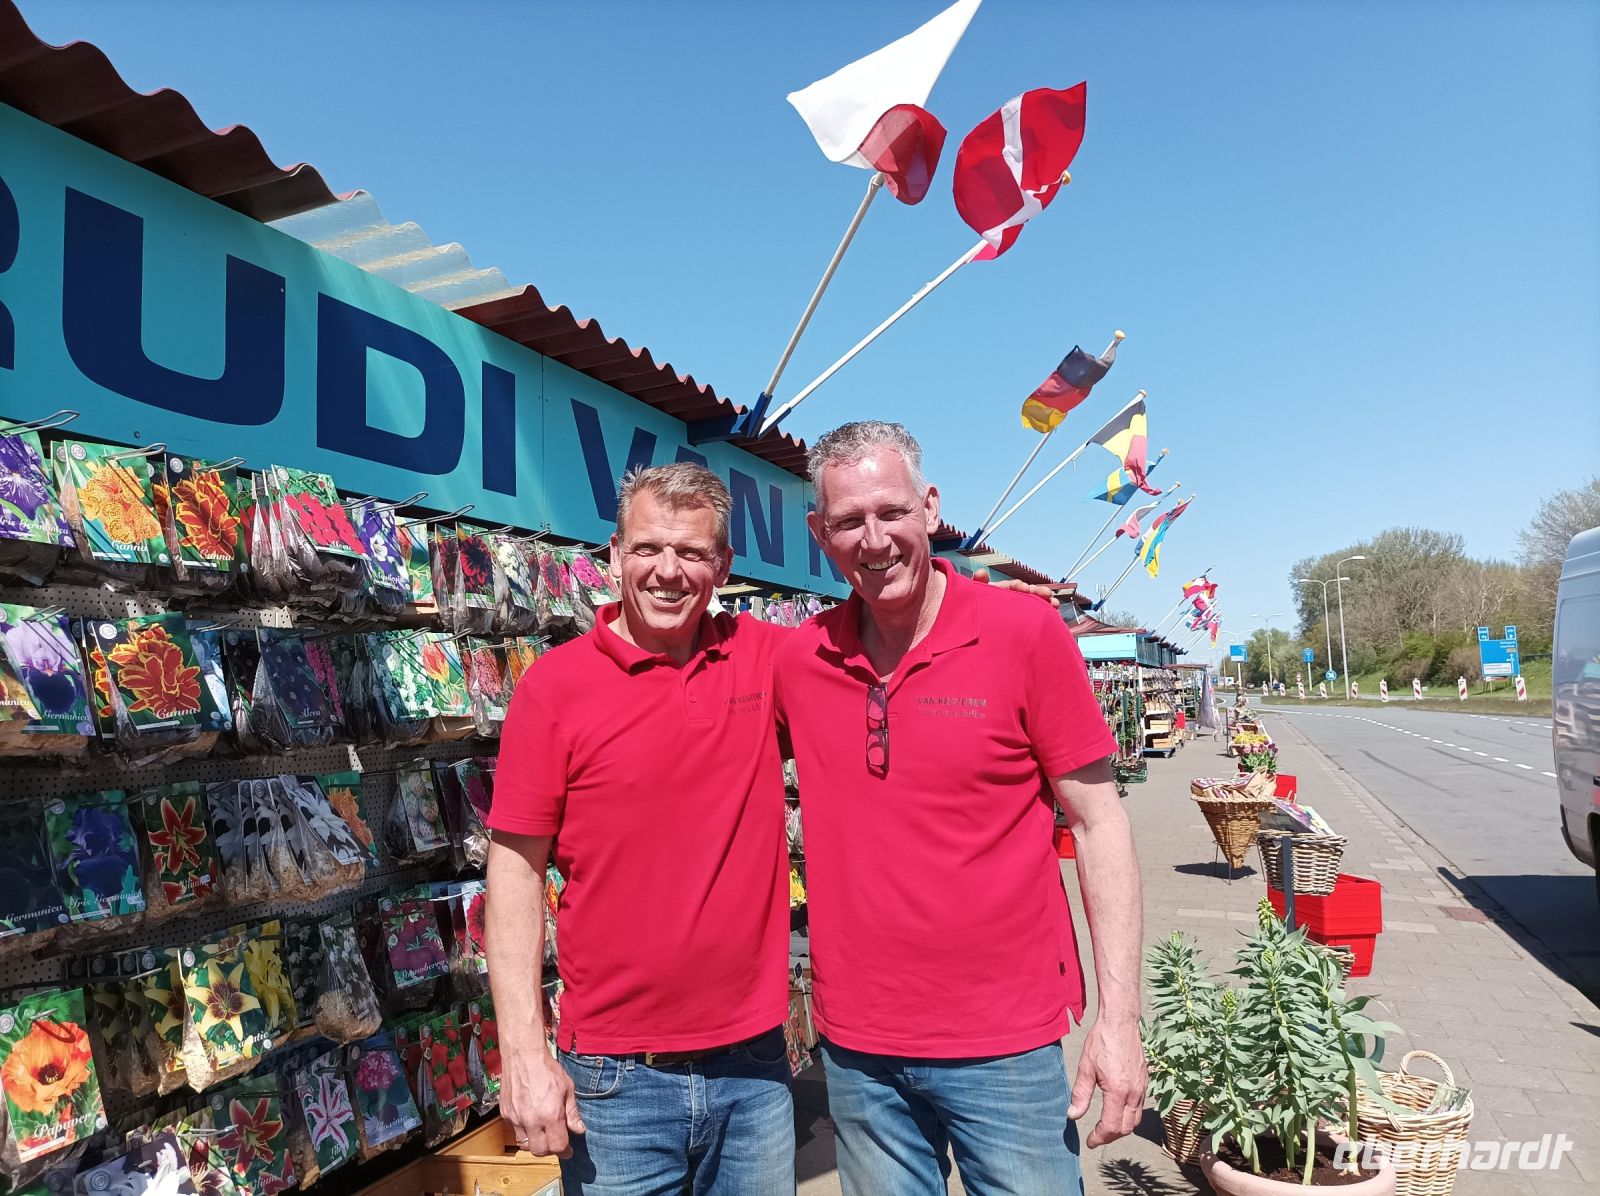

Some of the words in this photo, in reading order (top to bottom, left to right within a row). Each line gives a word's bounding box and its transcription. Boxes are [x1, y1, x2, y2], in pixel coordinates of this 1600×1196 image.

[0, 174, 517, 497] UDI
[570, 397, 785, 568] VN
[111, 540, 148, 552] Canna
[156, 707, 197, 720] Canna
[5, 905, 63, 921] Germanica
[34, 1113, 91, 1140] Papaver
